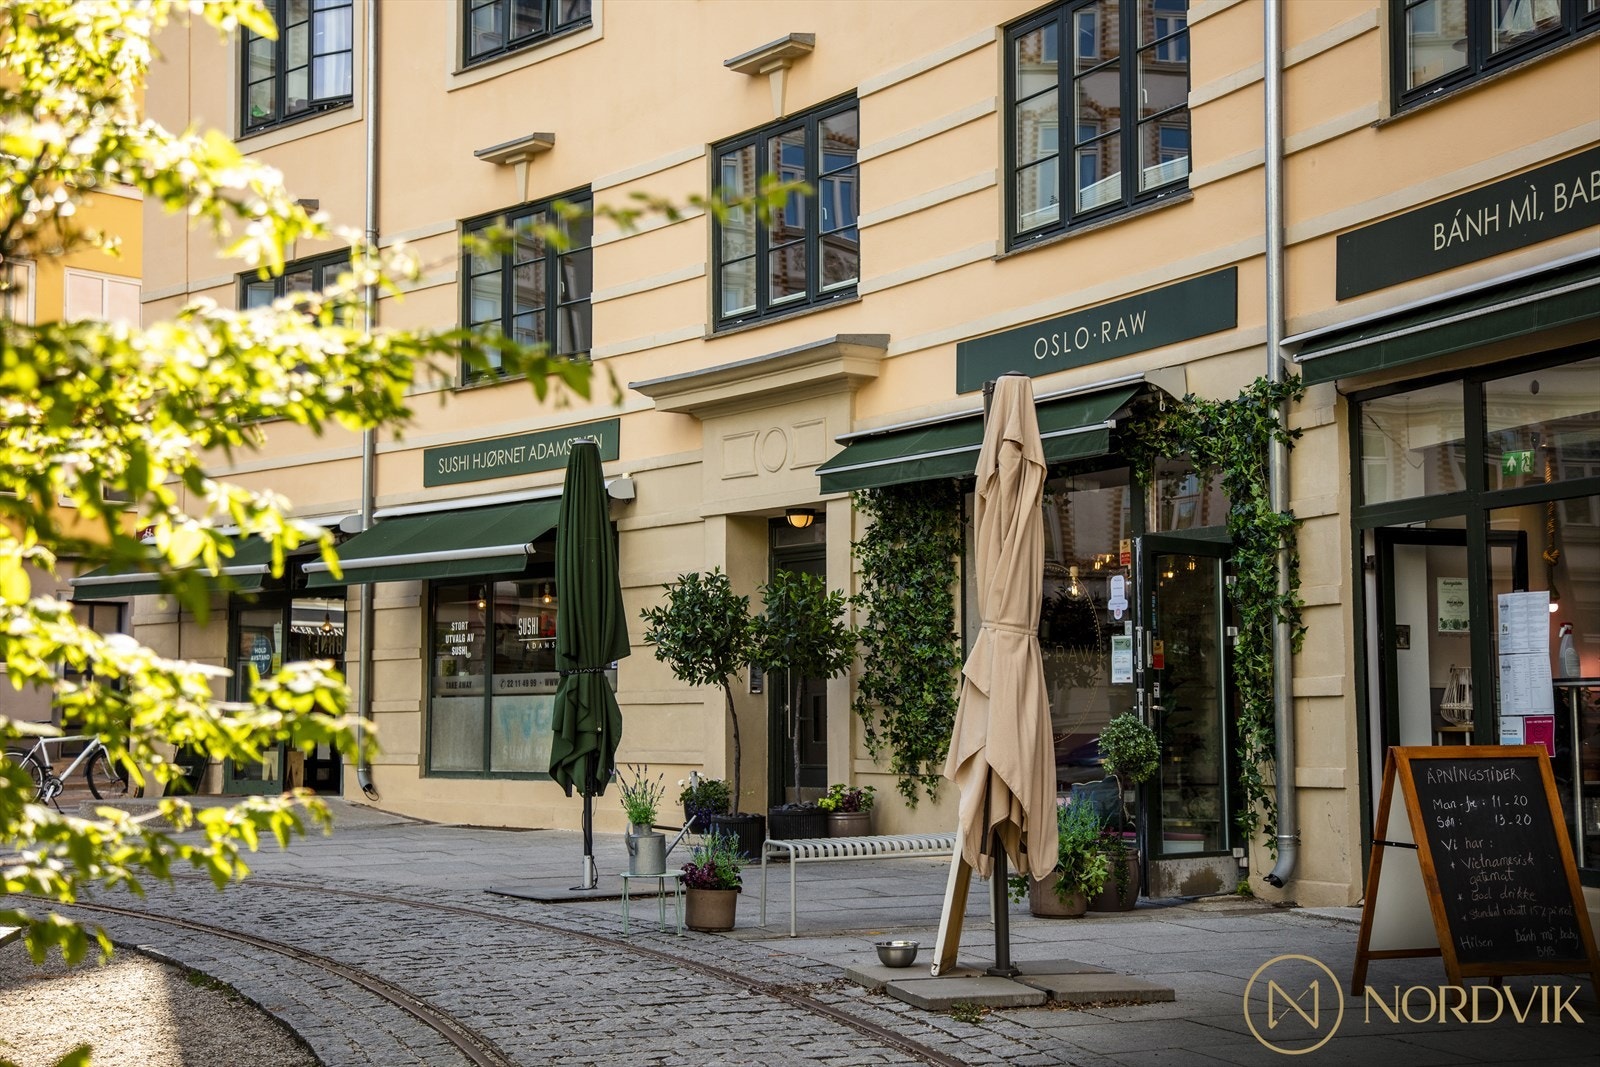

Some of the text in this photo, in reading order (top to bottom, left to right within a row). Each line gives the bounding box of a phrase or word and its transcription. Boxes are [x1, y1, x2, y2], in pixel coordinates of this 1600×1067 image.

[1433, 203, 1500, 251] BÁNH
[1508, 185, 1544, 228] MÌ,
[438, 433, 603, 475] SUSHI HJØRNET ADAMSN
[451, 621, 468, 631] STORT
[518, 617, 539, 636] SUSHI
[445, 633, 474, 644] UTVALG AV
[452, 646, 468, 656] SUSHI
[525, 641, 557, 650] ADAMS
[250, 653, 271, 661] AVSTAND
[1055, 645, 1095, 664] RAW
[445, 681, 472, 690] TAKE AWAY
[507, 680, 514, 688] 22
[515, 680, 521, 688] 11
[1441, 839, 1458, 850] Vi
[1460, 852, 1535, 870] Vietnamesisk
[1472, 885, 1537, 902] God drikke
[1460, 936, 1493, 950] Hilsen
